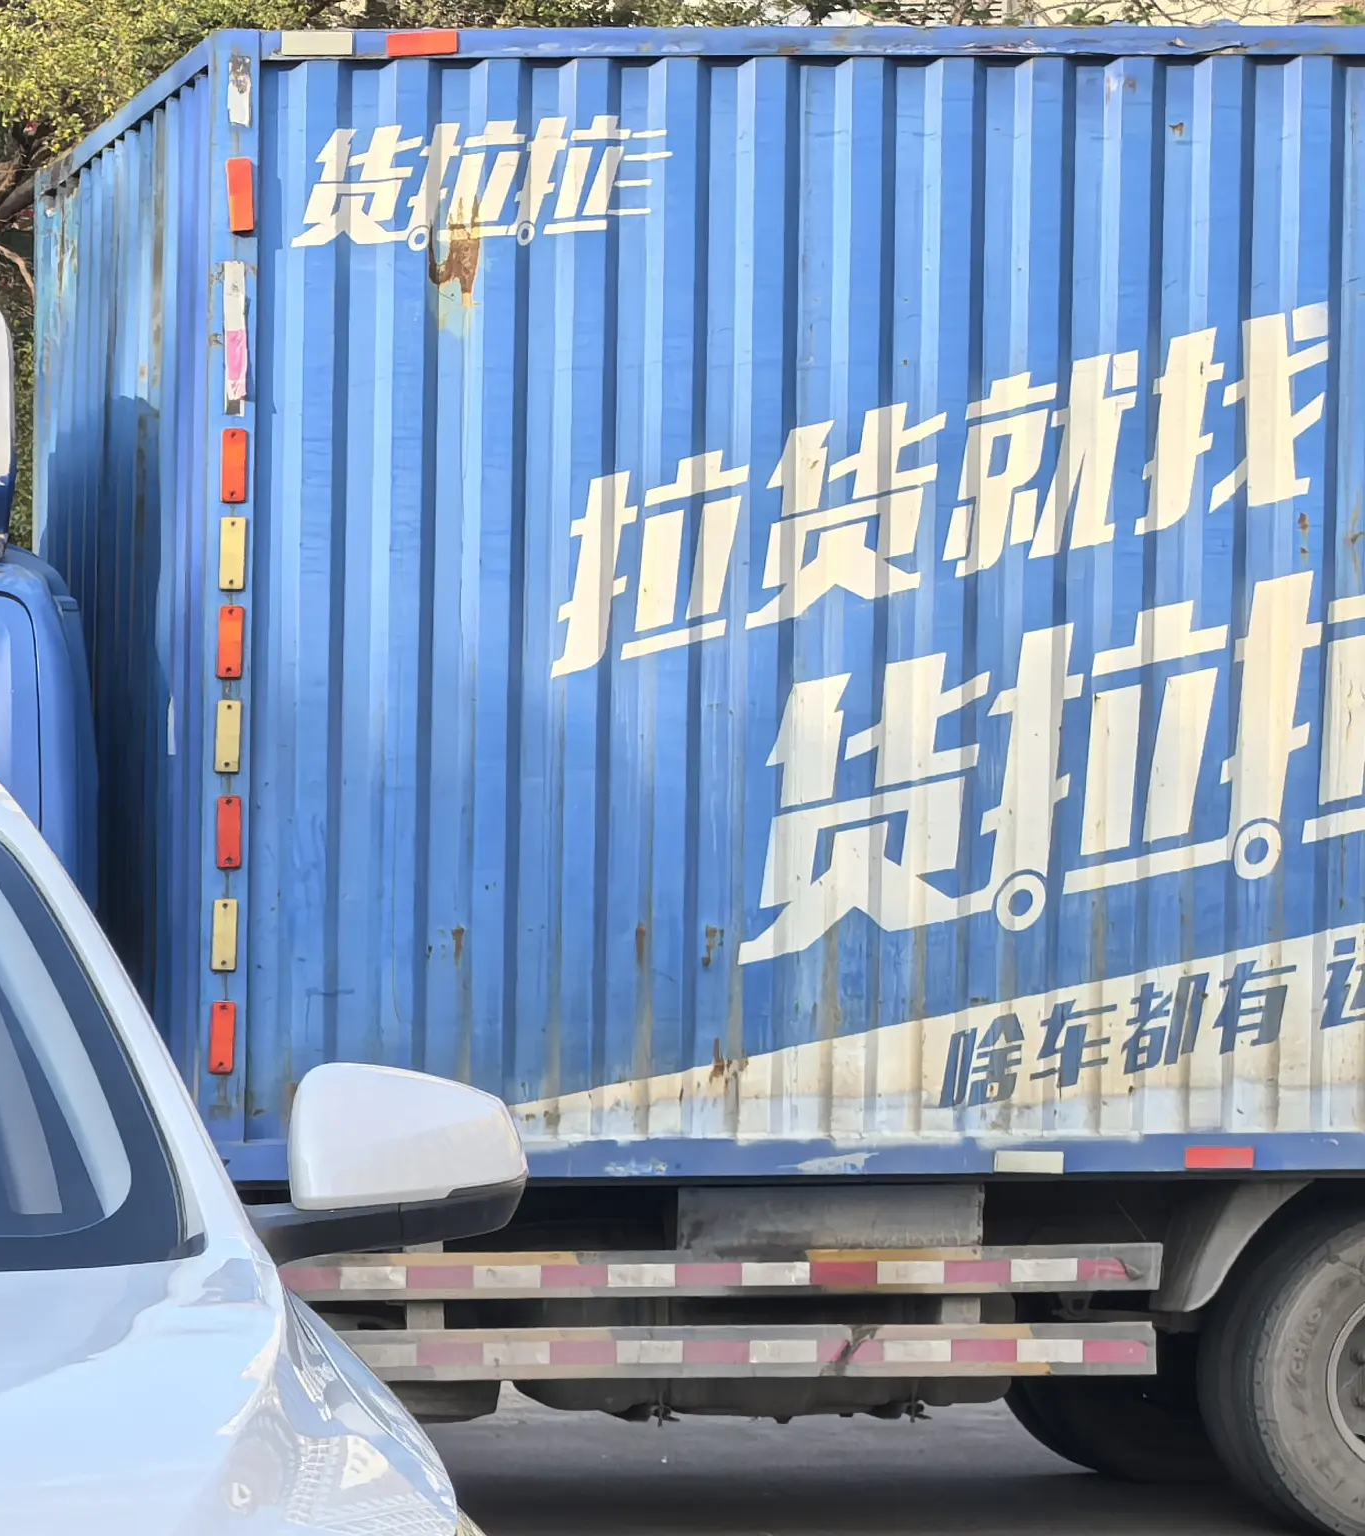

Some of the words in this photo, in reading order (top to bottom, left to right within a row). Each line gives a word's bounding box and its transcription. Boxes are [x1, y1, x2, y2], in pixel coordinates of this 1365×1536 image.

[290, 114, 672, 251] 货拉拉
[550, 302, 1330, 678] 拉货就找
